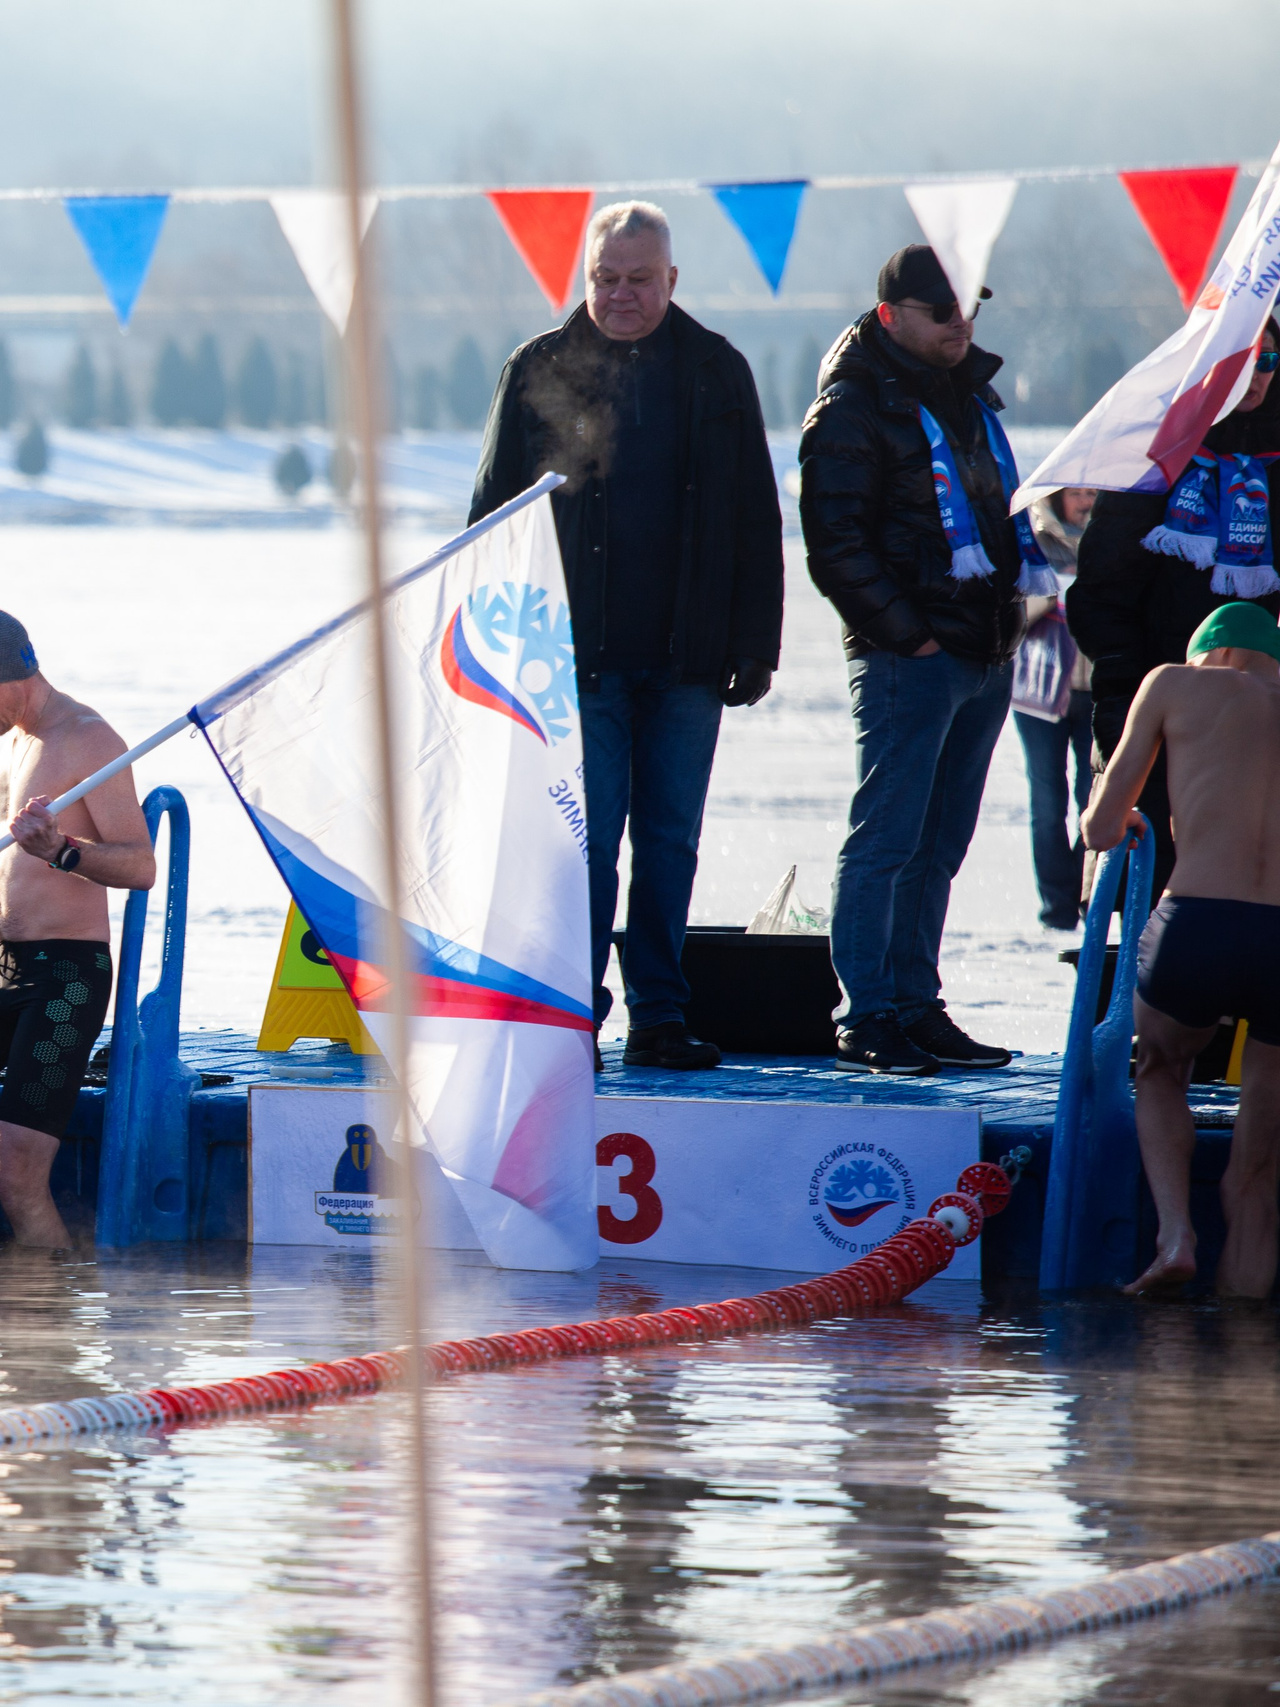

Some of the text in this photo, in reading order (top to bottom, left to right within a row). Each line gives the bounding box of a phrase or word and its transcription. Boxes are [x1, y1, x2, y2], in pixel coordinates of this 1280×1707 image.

[319, 1196, 374, 1209] Федерация
[596, 1132, 663, 1245] 3
[808, 1142, 916, 1210] ВСЕРОССИЙСКАЯ ФЕДЕРАЦИЯ
[813, 1213, 857, 1253] ЗИМНЕГО
